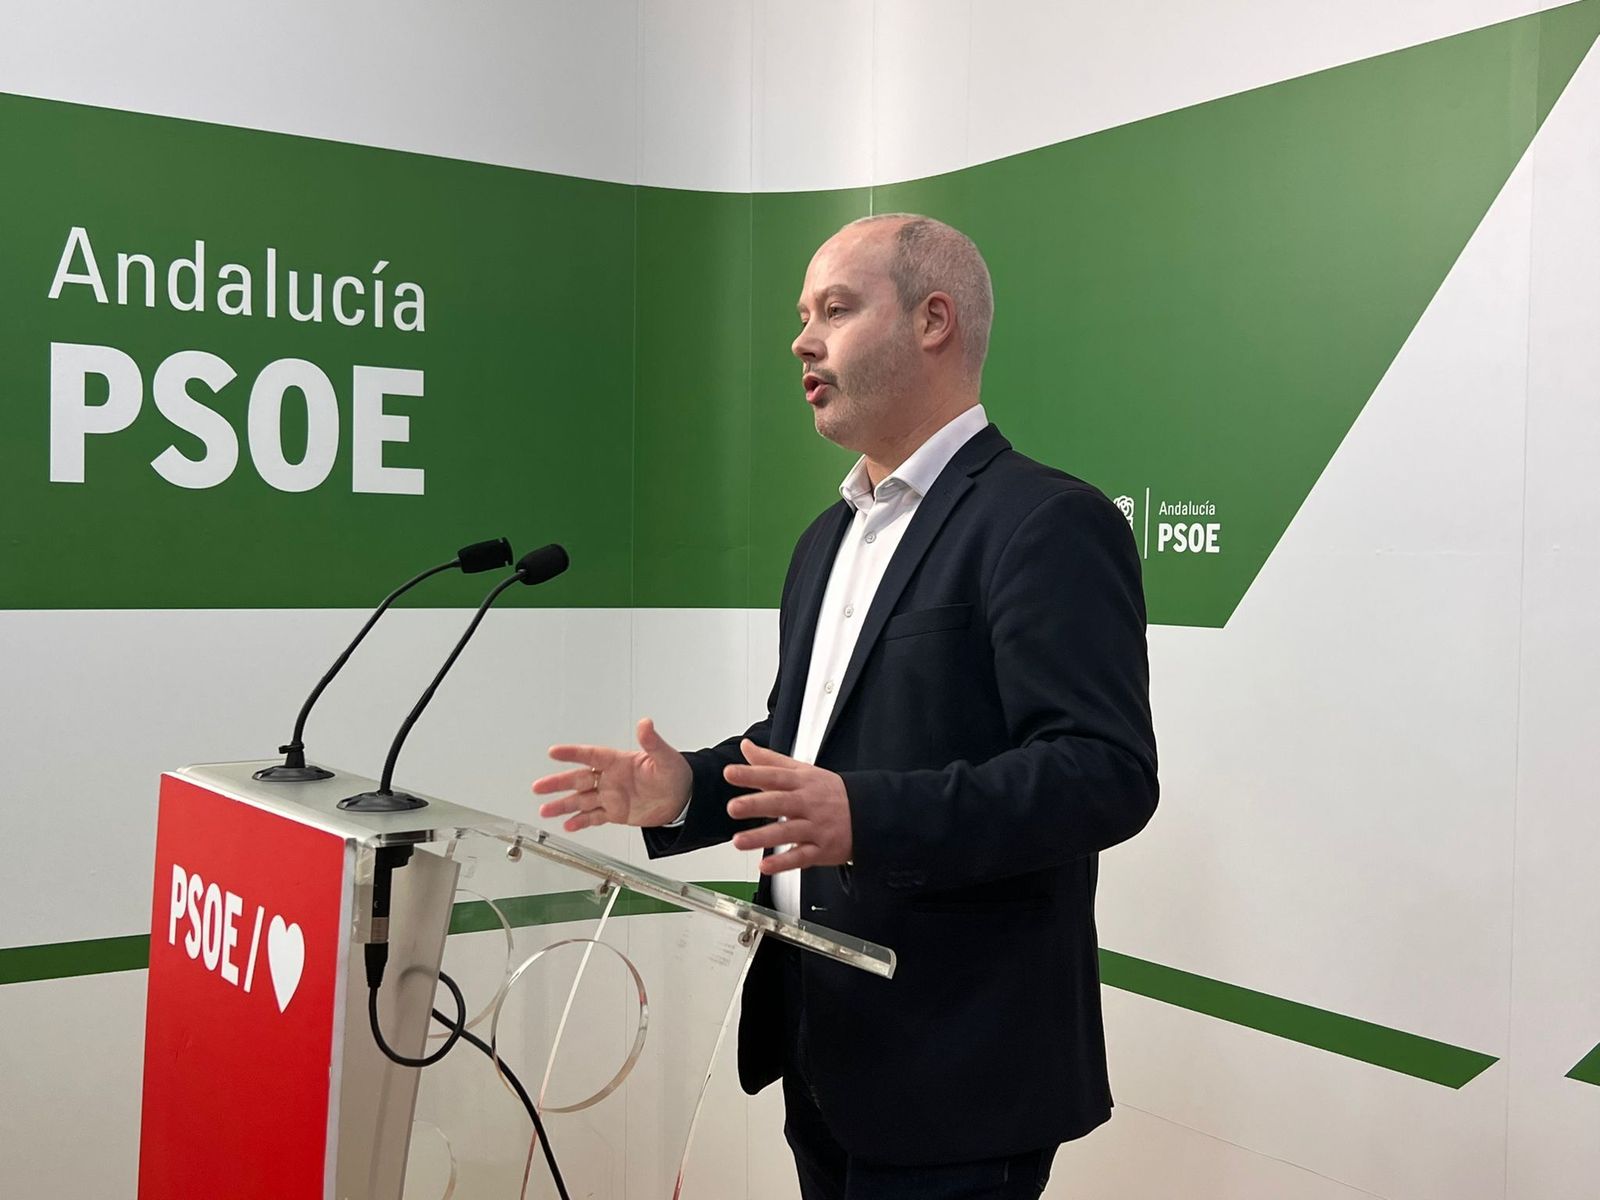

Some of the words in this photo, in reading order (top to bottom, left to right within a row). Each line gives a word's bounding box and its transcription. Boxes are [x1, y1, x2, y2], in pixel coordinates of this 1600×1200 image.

[48, 226, 425, 332] Andalucía
[49, 342, 425, 496] PSOE
[1157, 522, 1221, 554] PSOE
[1158, 500, 1216, 516] Andalucía
[168, 863, 243, 986] PSOE
